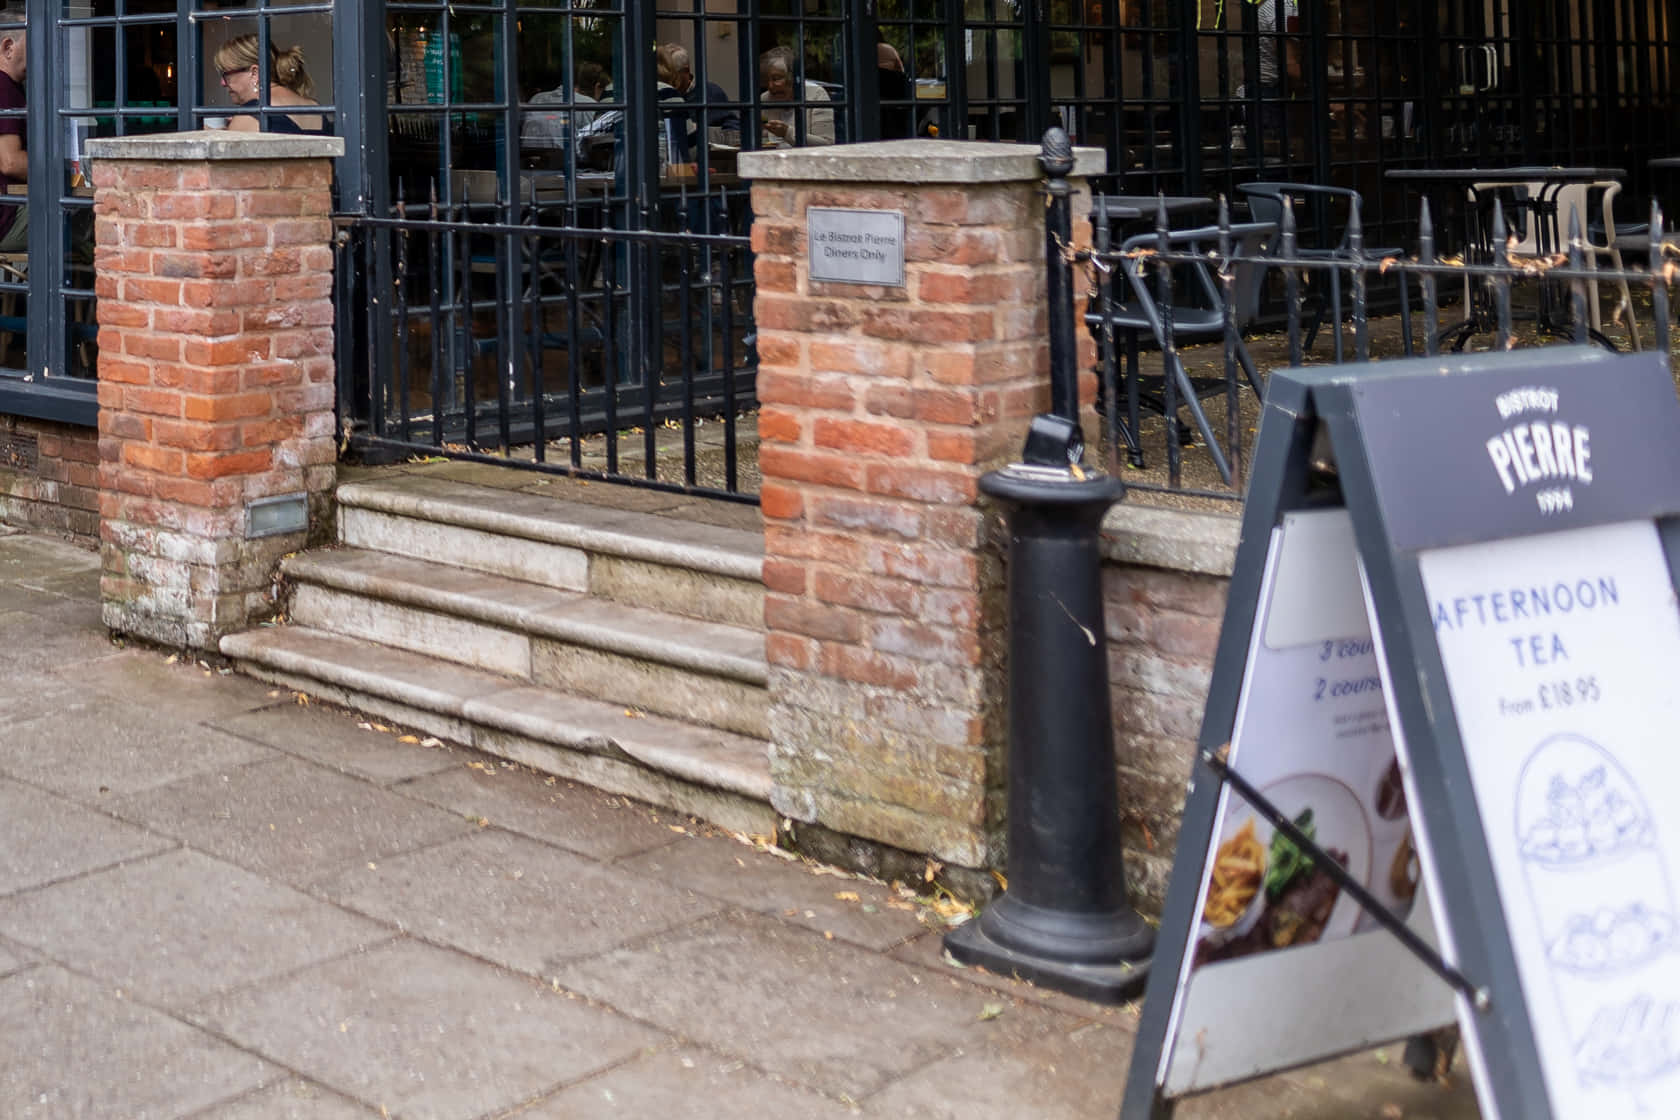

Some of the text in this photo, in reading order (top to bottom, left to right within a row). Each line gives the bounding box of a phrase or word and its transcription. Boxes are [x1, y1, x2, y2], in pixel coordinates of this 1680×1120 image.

[860, 248, 887, 263] Only
[1495, 386, 1560, 420] BISTROT
[1485, 420, 1594, 495] PIERRE
[1433, 576, 1620, 632] AFTERNOON
[1320, 639, 1334, 662] 3
[1509, 632, 1570, 667] TEA
[1313, 677, 1327, 702] 2
